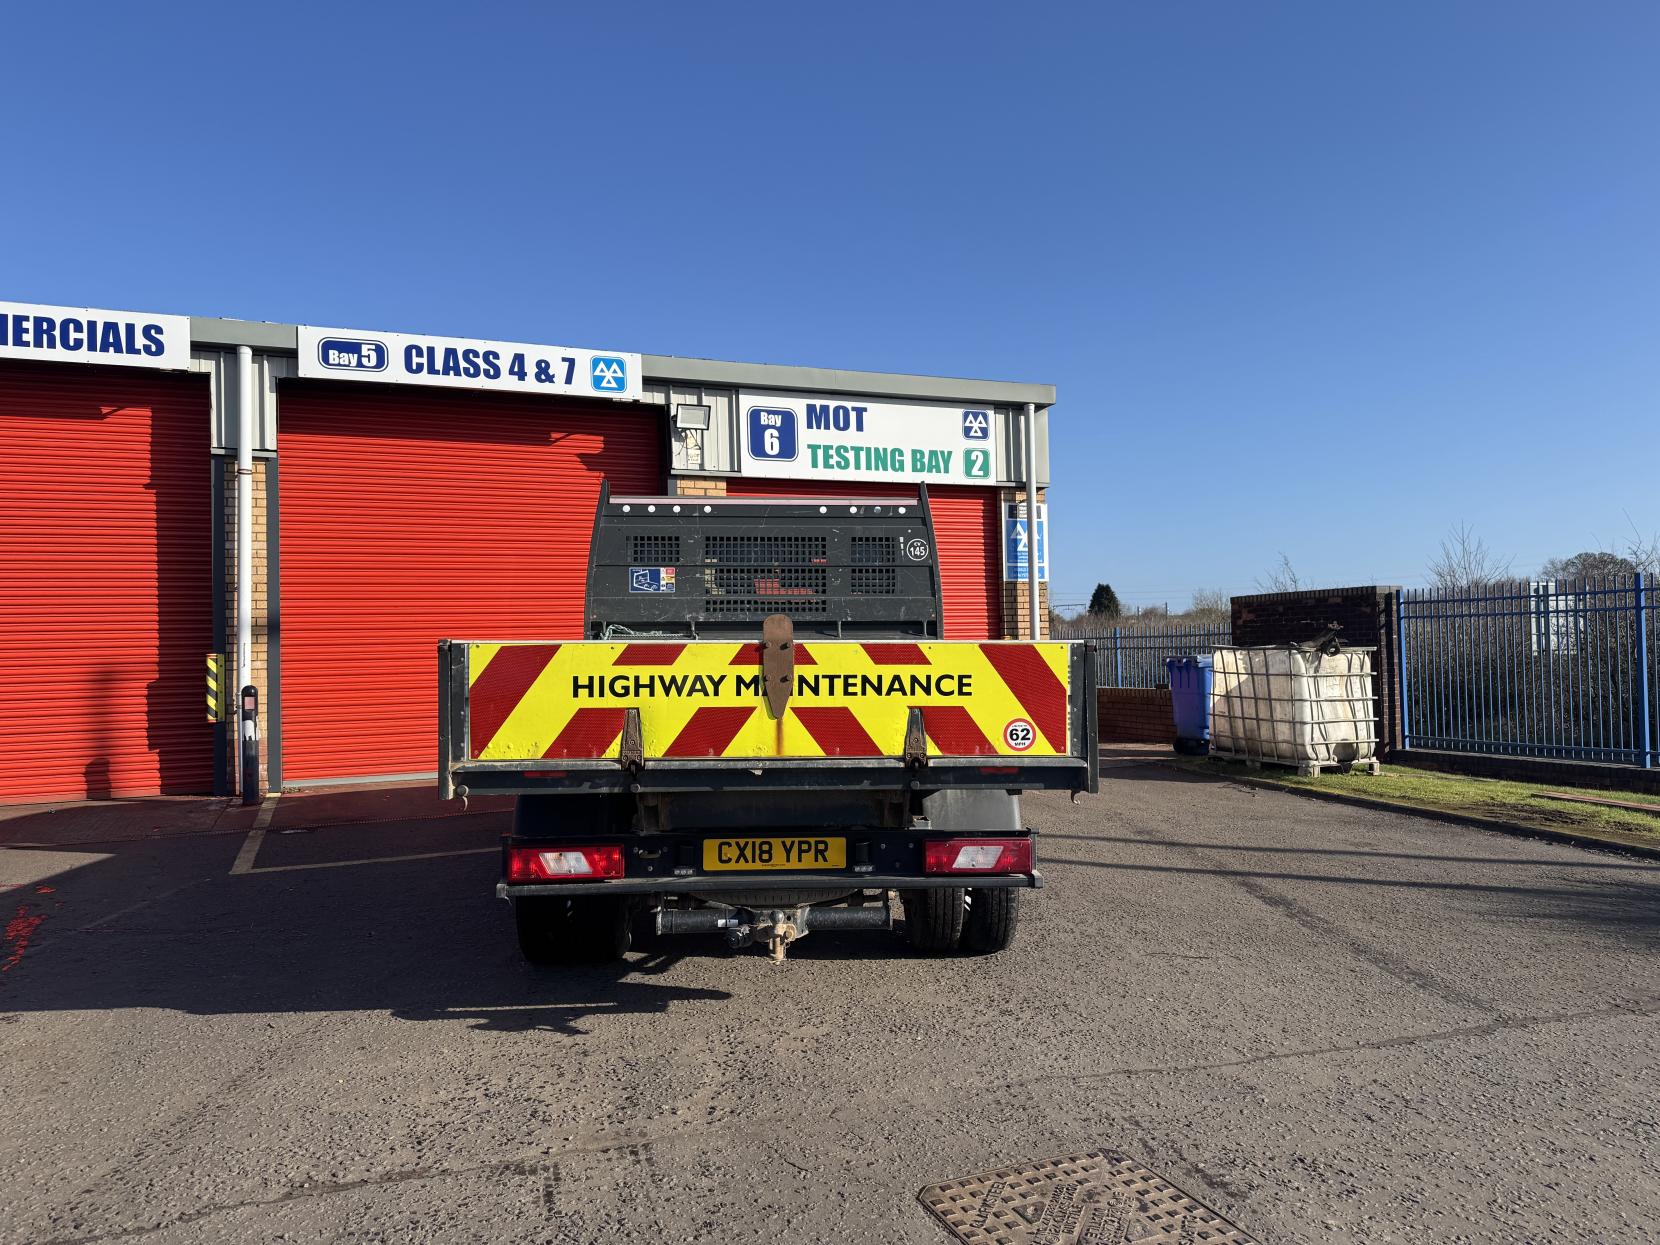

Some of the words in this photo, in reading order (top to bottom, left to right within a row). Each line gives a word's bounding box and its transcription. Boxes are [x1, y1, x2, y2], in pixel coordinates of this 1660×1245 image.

[328, 349, 358, 367] Bay
[361, 344, 377, 367] 5
[403, 344, 502, 380] CLASS
[508, 352, 528, 381] 4
[534, 358, 556, 384] &
[561, 356, 576, 385] 7
[760, 411, 782, 427] Bay
[806, 403, 868, 432] MOT
[764, 428, 780, 455] 6
[806, 443, 905, 473] TESTING
[911, 448, 953, 474] BAY
[970, 450, 984, 476] 2
[910, 546, 926, 557] 145
[572, 674, 728, 698] HIGHWAY
[736, 673, 972, 697] MNTENANCE
[1009, 727, 1031, 741] 62
[717, 839, 773, 864] CX18
[780, 838, 829, 863] YPR
